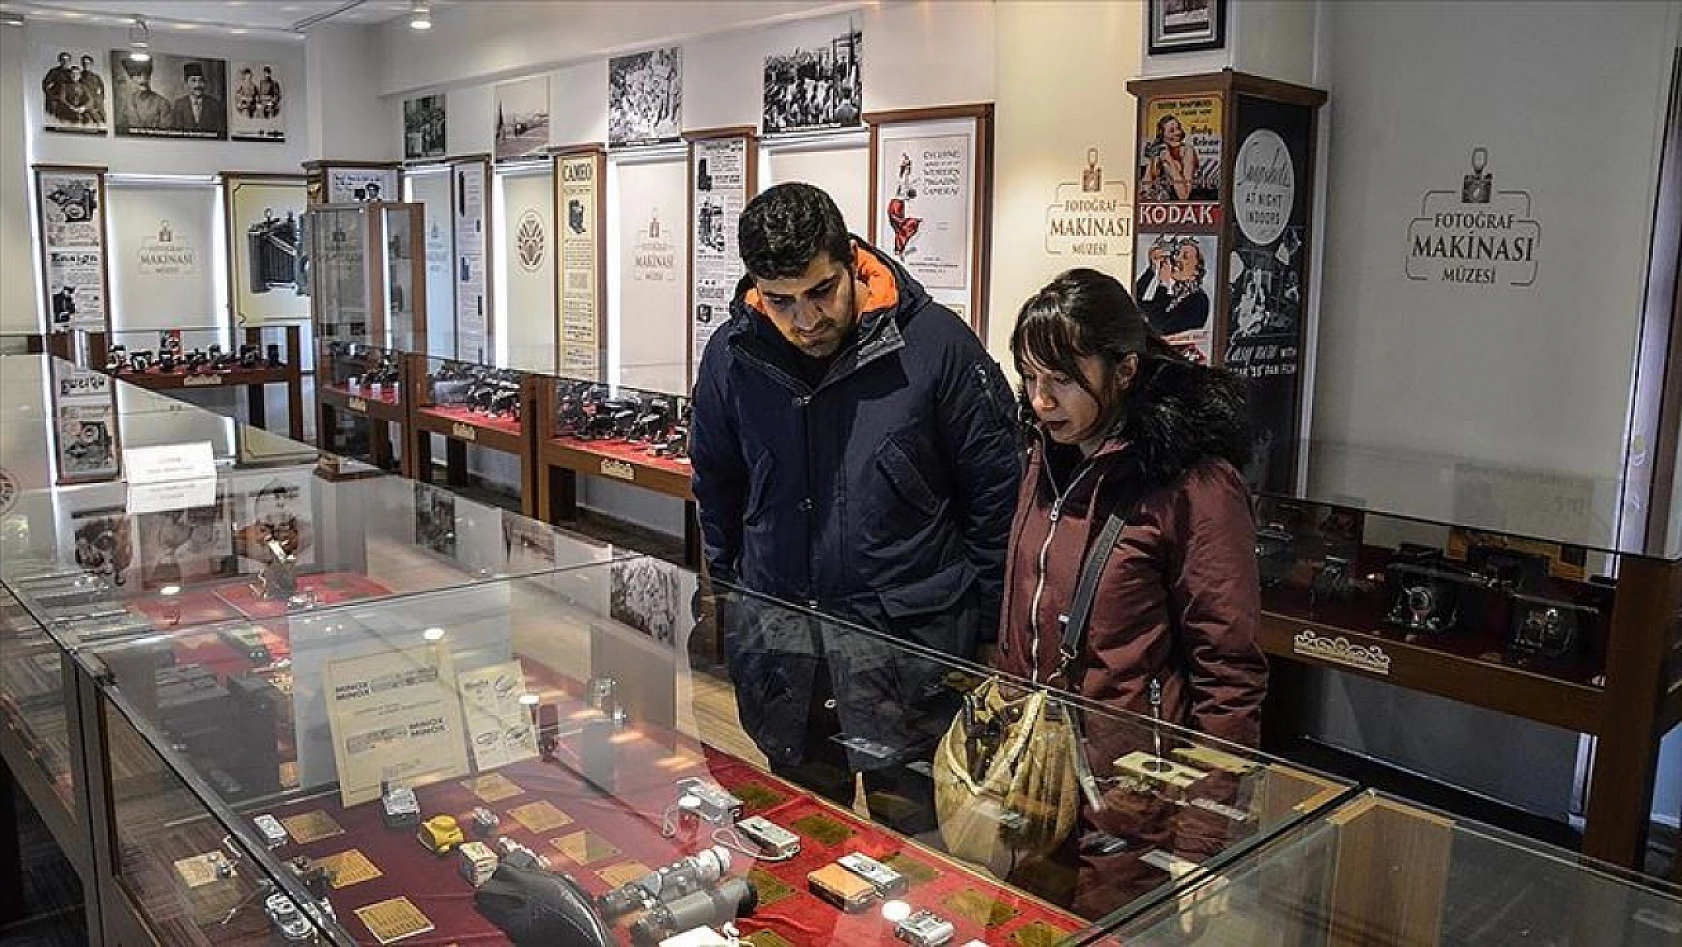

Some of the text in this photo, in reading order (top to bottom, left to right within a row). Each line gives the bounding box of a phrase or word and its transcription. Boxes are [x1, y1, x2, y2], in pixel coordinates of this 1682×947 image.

[563, 163, 593, 181] CAMEO
[1139, 205, 1214, 224] KODAK
[1435, 212, 1515, 229] FOTOĞRAF
[1050, 215, 1131, 237] MAKİNASI
[1412, 231, 1535, 262] MAKİNASI
[1442, 265, 1496, 284] MÜZESİ
